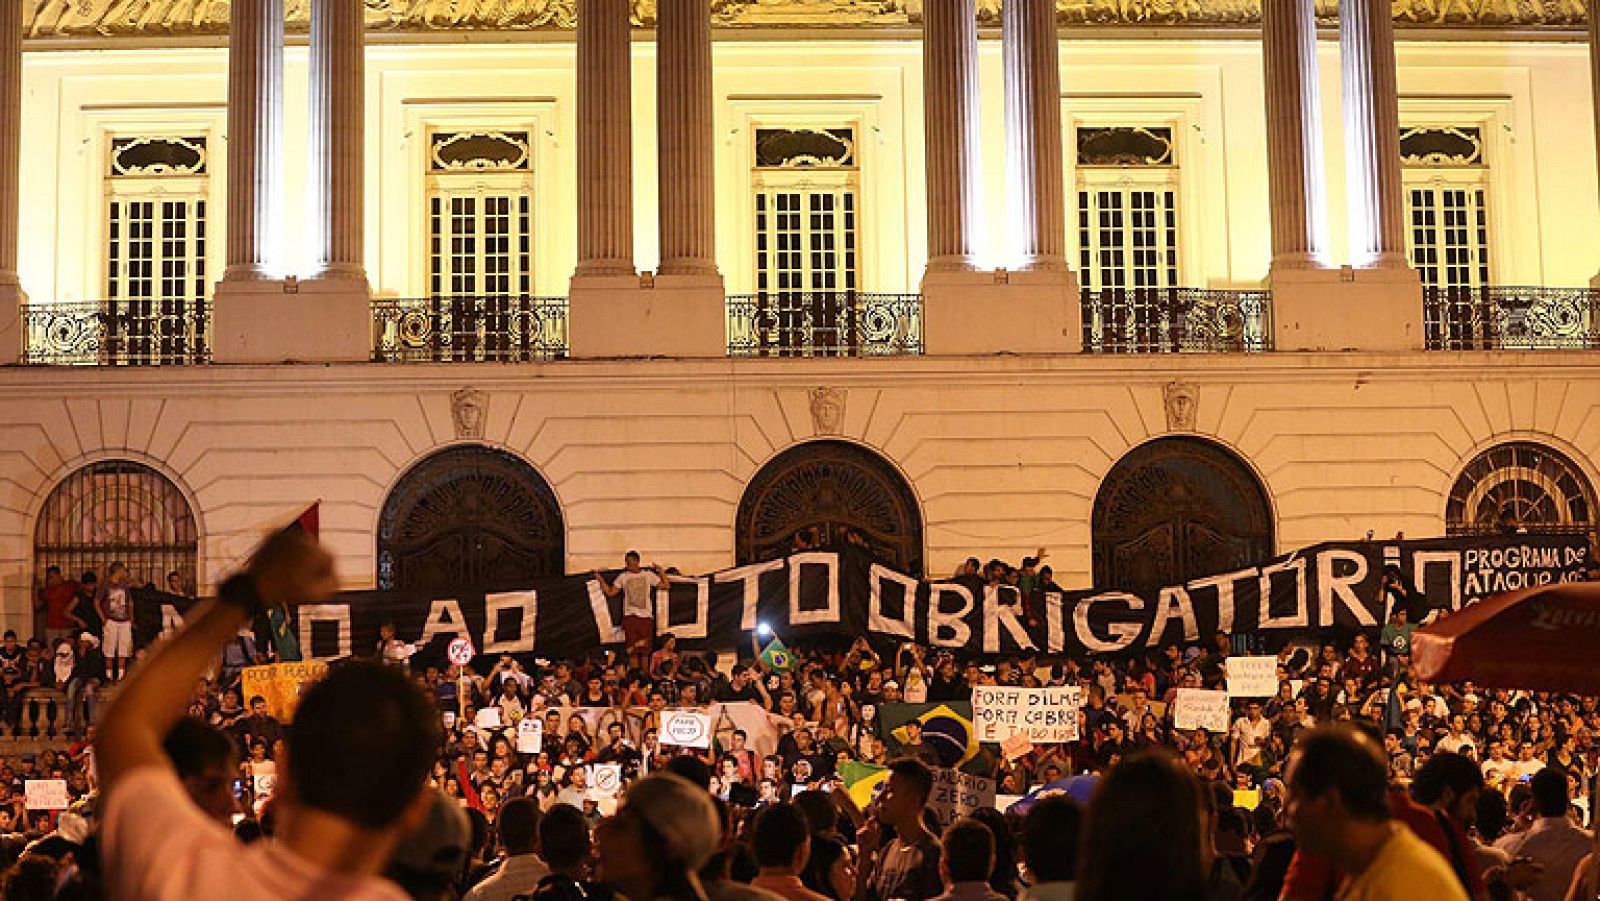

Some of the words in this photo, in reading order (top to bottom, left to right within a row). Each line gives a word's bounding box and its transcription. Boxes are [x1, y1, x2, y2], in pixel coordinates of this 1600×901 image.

[1464, 544, 1561, 571] PROGRAMA
[416, 590, 537, 654] AO
[585, 552, 841, 643] VOTO
[974, 690, 1019, 706] FORA
[974, 706, 1018, 723] FORA
